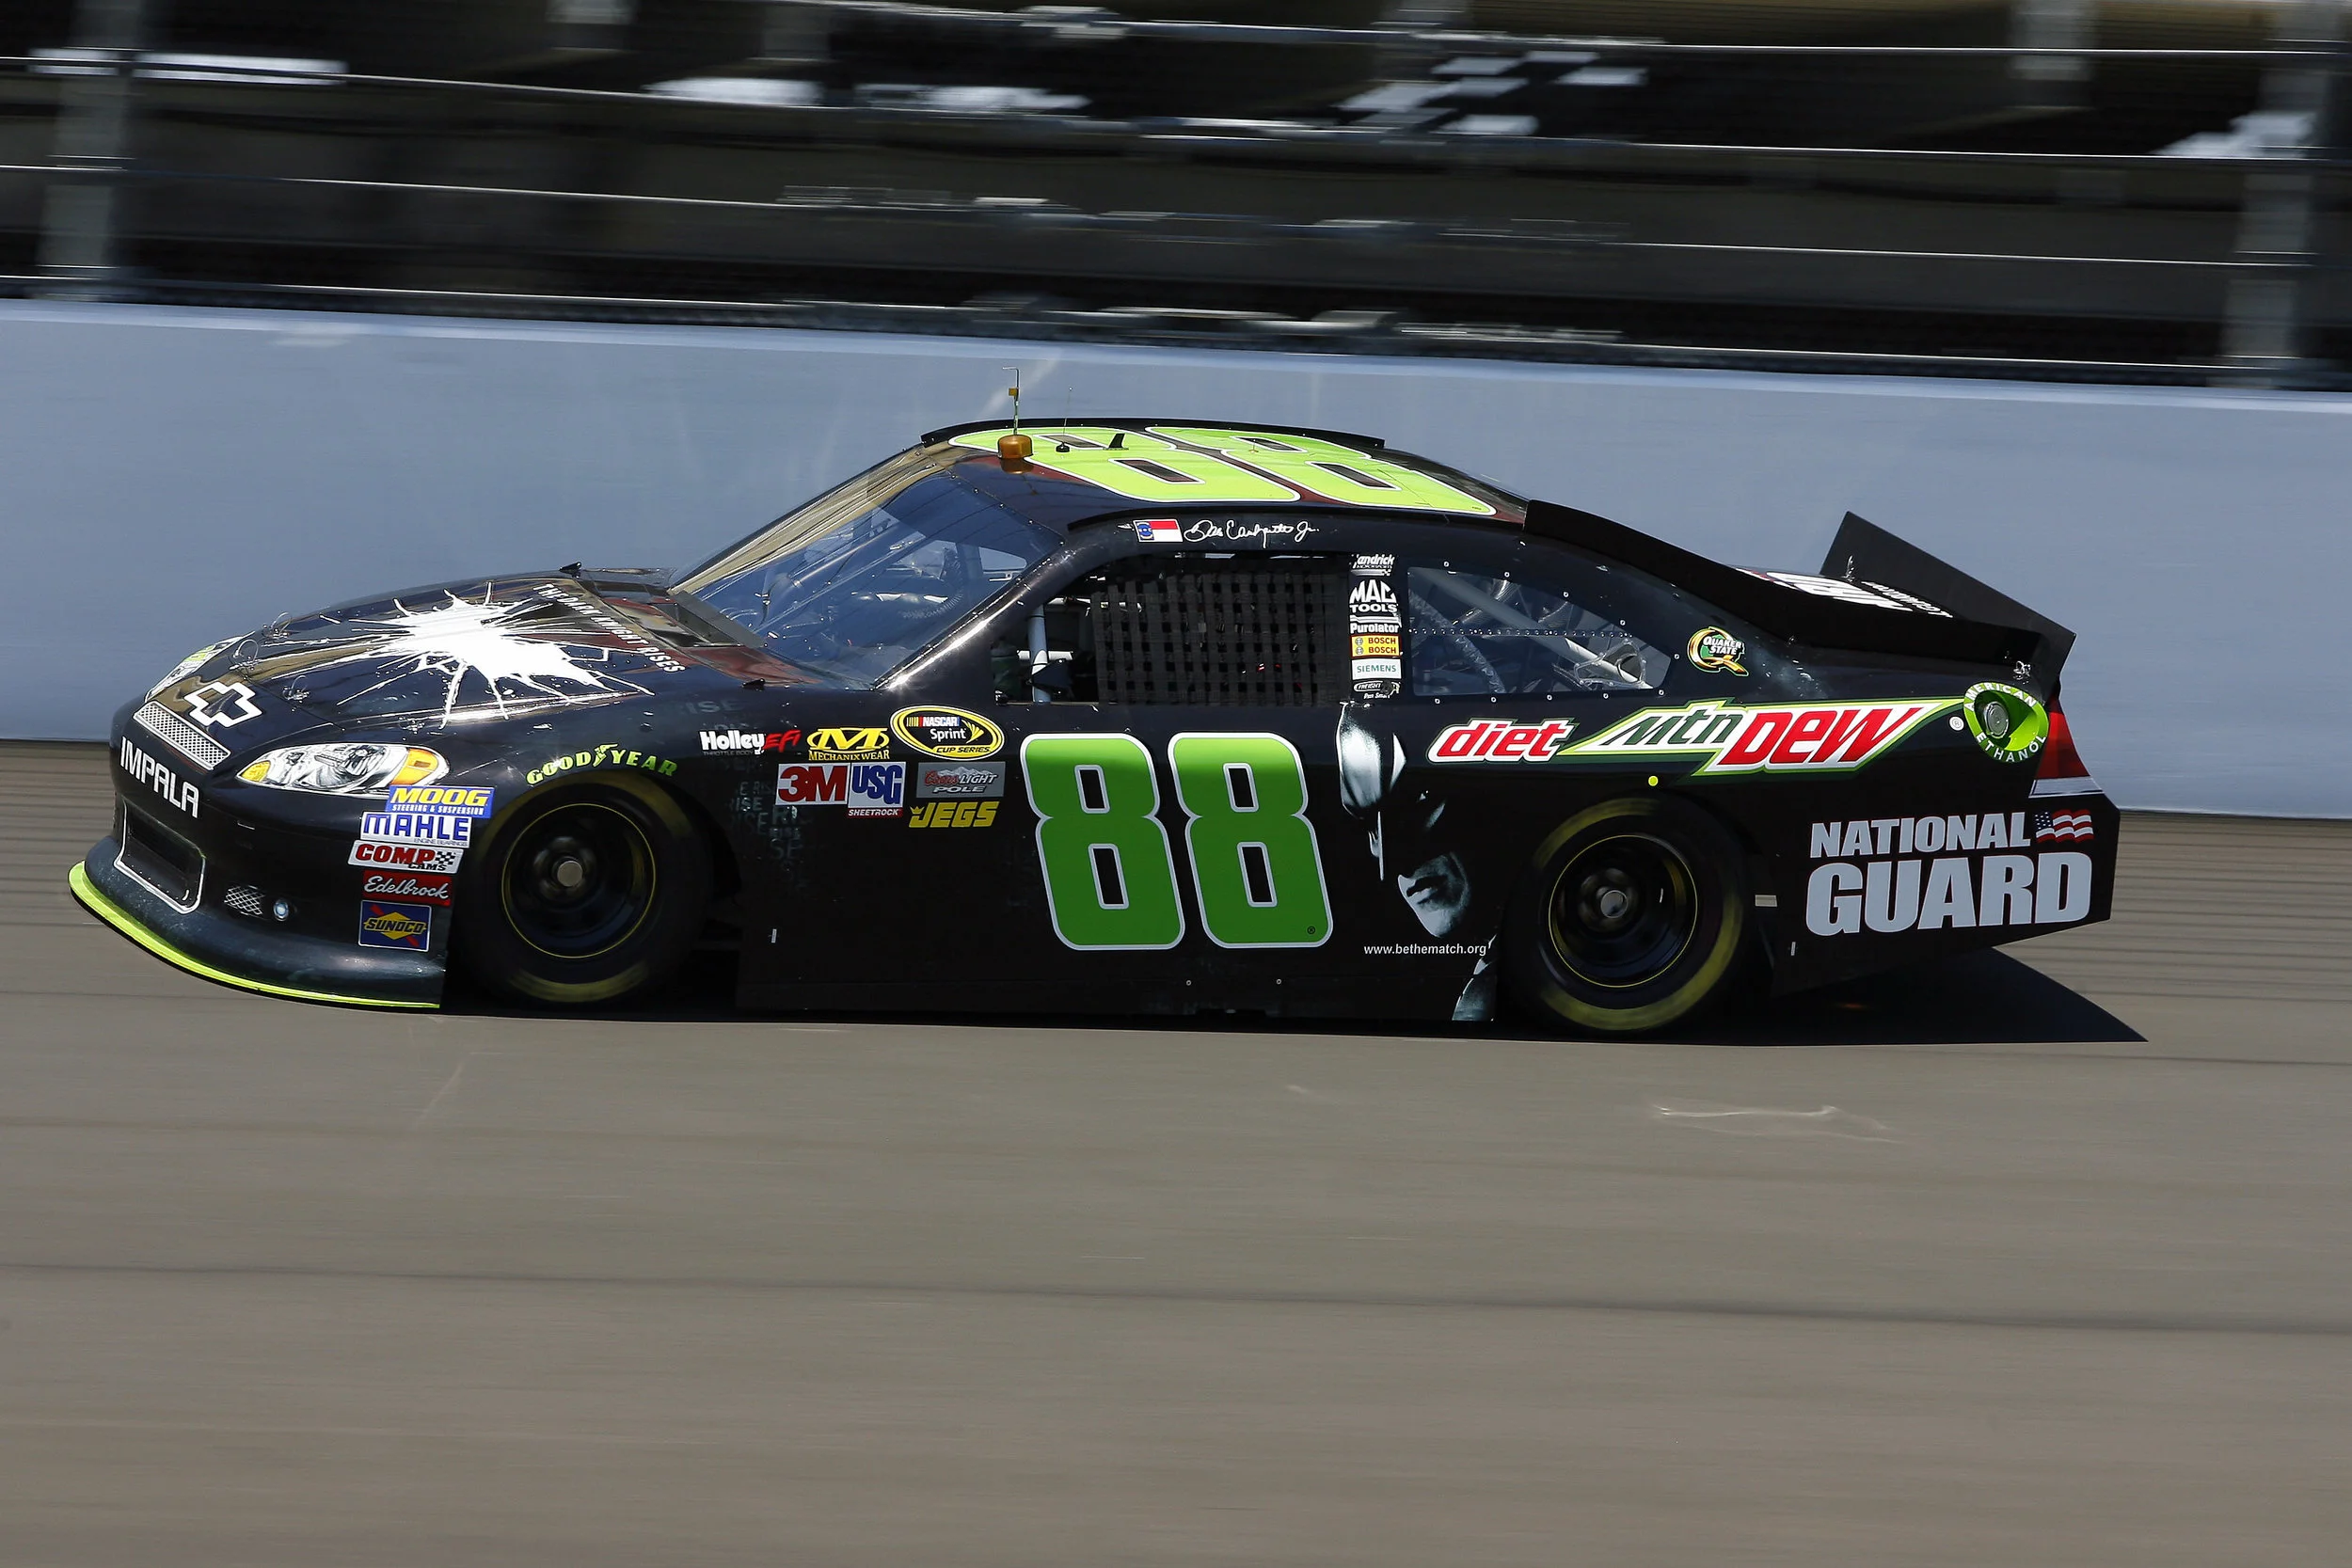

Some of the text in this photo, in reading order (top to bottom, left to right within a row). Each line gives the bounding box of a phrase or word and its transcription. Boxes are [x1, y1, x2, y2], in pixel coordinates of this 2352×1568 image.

[948, 426, 1498, 515] 88
[1349, 579, 1397, 604] MAC
[1349, 604, 1398, 613] TOOLS
[557, 596, 603, 615] DARK
[591, 617, 649, 644] KNIGHT
[637, 647, 686, 673] RISES
[1350, 623, 1399, 634] Purolator
[1703, 636, 1742, 649] QUAKER
[1709, 646, 1738, 655] STATE
[1963, 682, 2037, 712] AMERICAN
[923, 717, 959, 727] NASCAR
[1436, 721, 1572, 757] diet
[1603, 705, 1748, 748] Mtn
[699, 730, 766, 755] Holley
[930, 728, 966, 742] Sprint
[1976, 732, 2047, 762] ETHANOL
[526, 743, 678, 784] GOODYEAR
[808, 750, 890, 761] MECHANIX WEAR
[120, 736, 199, 818] IMPALA
[778, 765, 848, 802] 3M
[851, 765, 903, 804] USG
[960, 774, 997, 784] LIGHT
[390, 788, 491, 806] MOOG
[438, 806, 485, 816] SUSPENSION
[908, 801, 1000, 828] JEGS
[363, 814, 469, 841] MAHLE
[1810, 812, 2031, 858] NATIONAL
[356, 844, 436, 864] COMP
[1020, 733, 1334, 951] 88
[407, 863, 447, 871] CAMS
[364, 876, 449, 899] Edelbrock
[1805, 852, 2092, 936] GUARD
[366, 918, 425, 934] SUNOCO
[1364, 943, 1486, 957] www.bethematch.org
